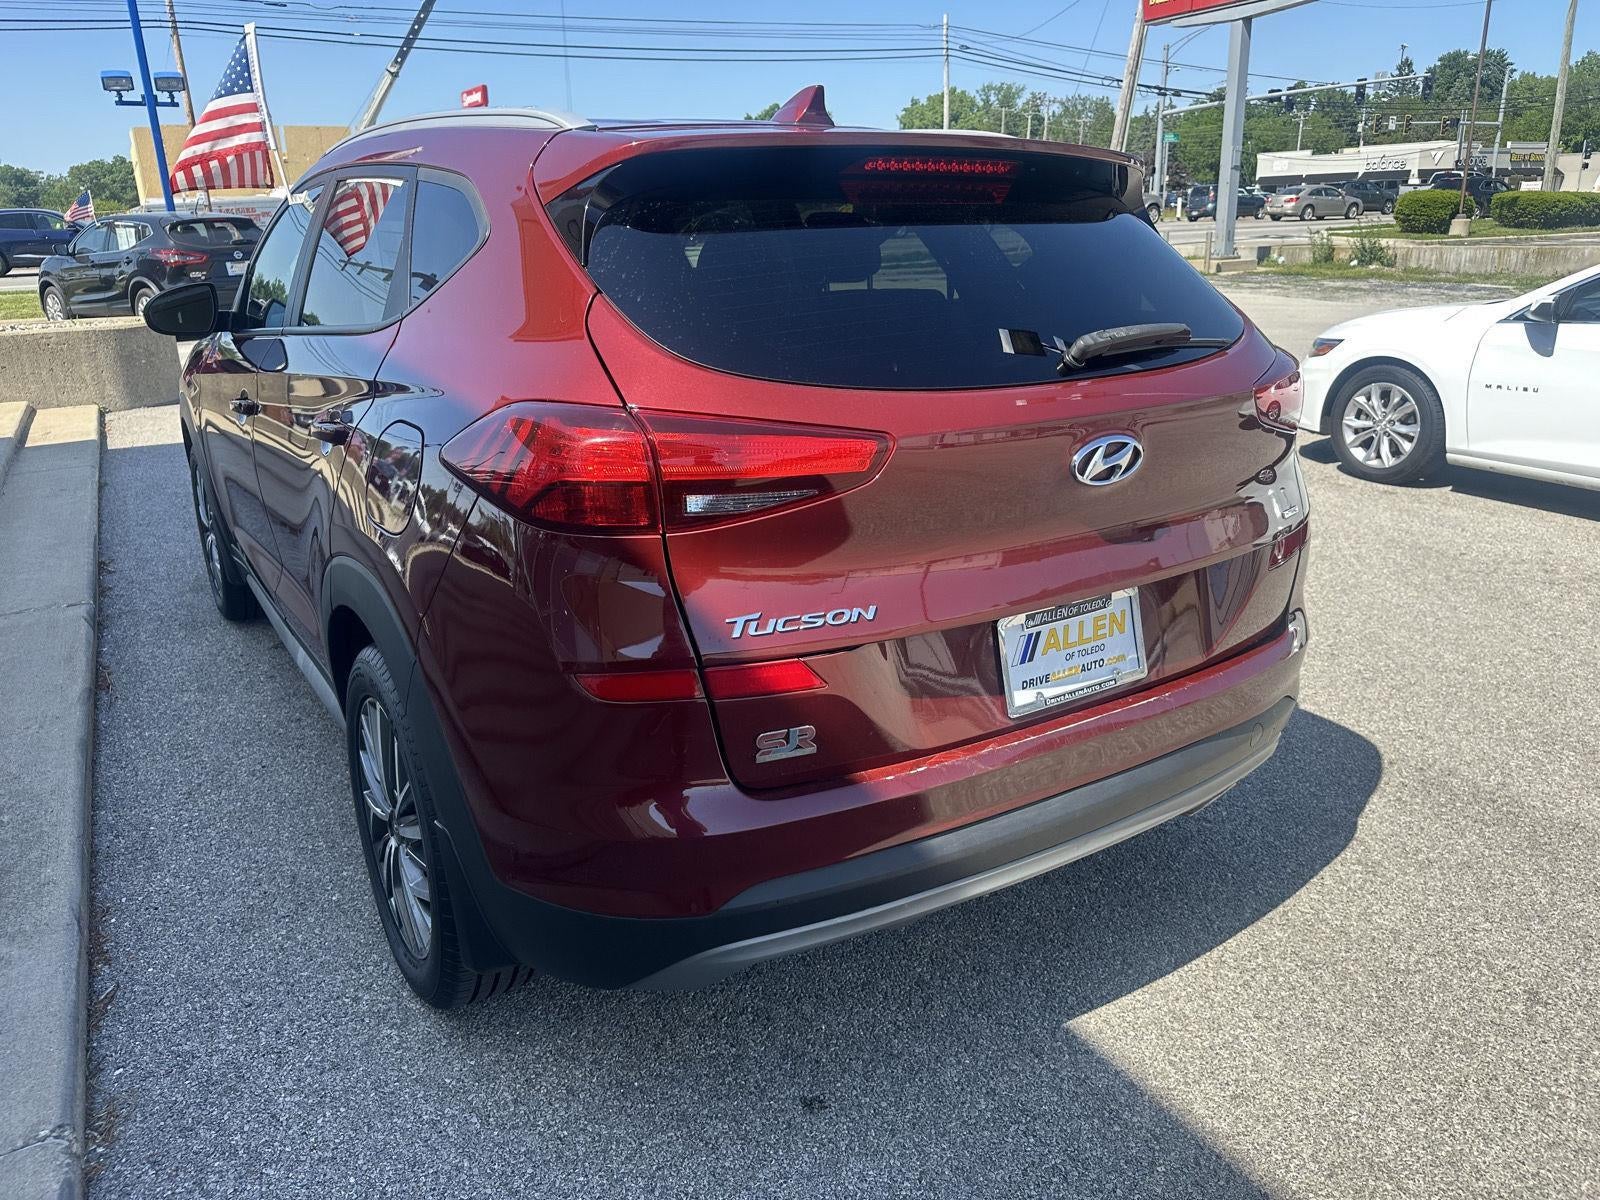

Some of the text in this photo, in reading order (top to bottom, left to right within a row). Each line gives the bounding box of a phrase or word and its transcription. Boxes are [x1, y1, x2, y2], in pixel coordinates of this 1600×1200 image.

[1364, 153, 1407, 171] balance
[1485, 384, 1539, 393] MALIBU
[1041, 598, 1106, 623] ALLEN OF TOLEDO
[725, 605, 878, 639] TUCSON
[1041, 609, 1127, 657] ALLEN
[1065, 643, 1106, 662] OF TOLEDO
